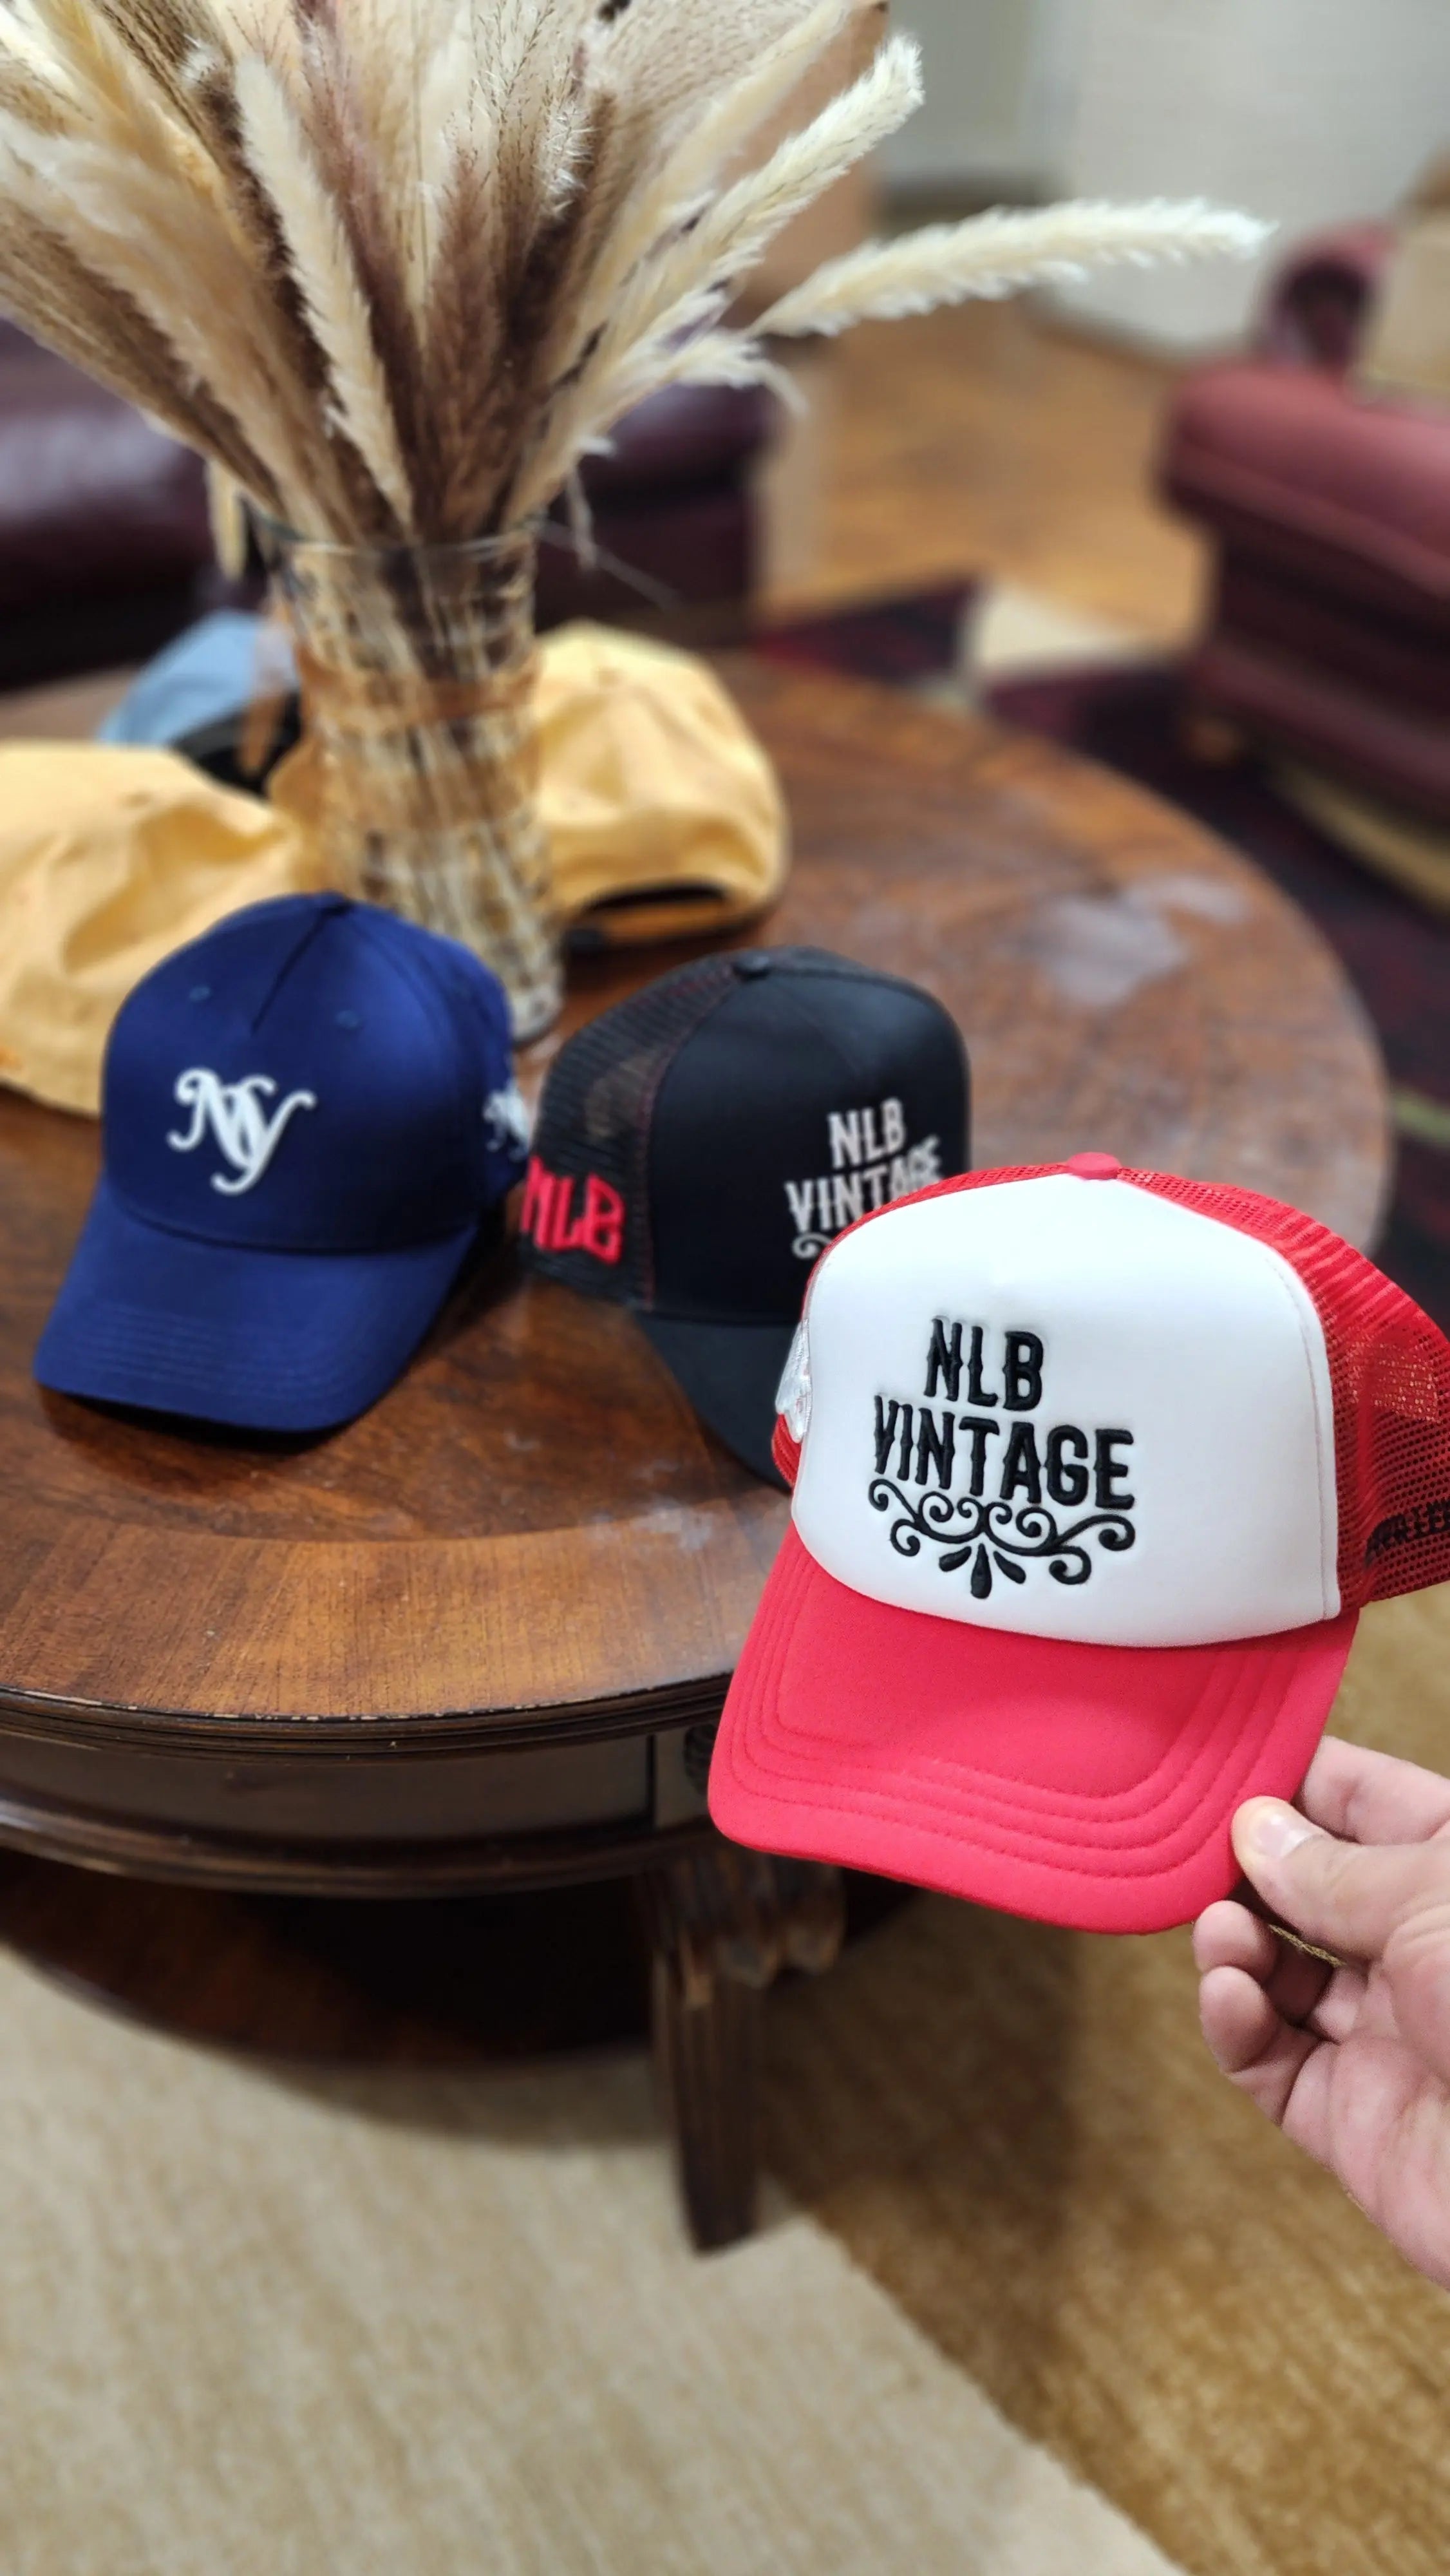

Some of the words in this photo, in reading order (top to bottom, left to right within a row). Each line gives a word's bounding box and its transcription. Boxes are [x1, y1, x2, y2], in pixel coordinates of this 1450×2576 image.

[827, 1096, 907, 1169] NLB
[520, 1155, 626, 1267] NLB
[923, 1317, 1044, 1412] NLB
[873, 1394, 1135, 1510] VINTAGE
